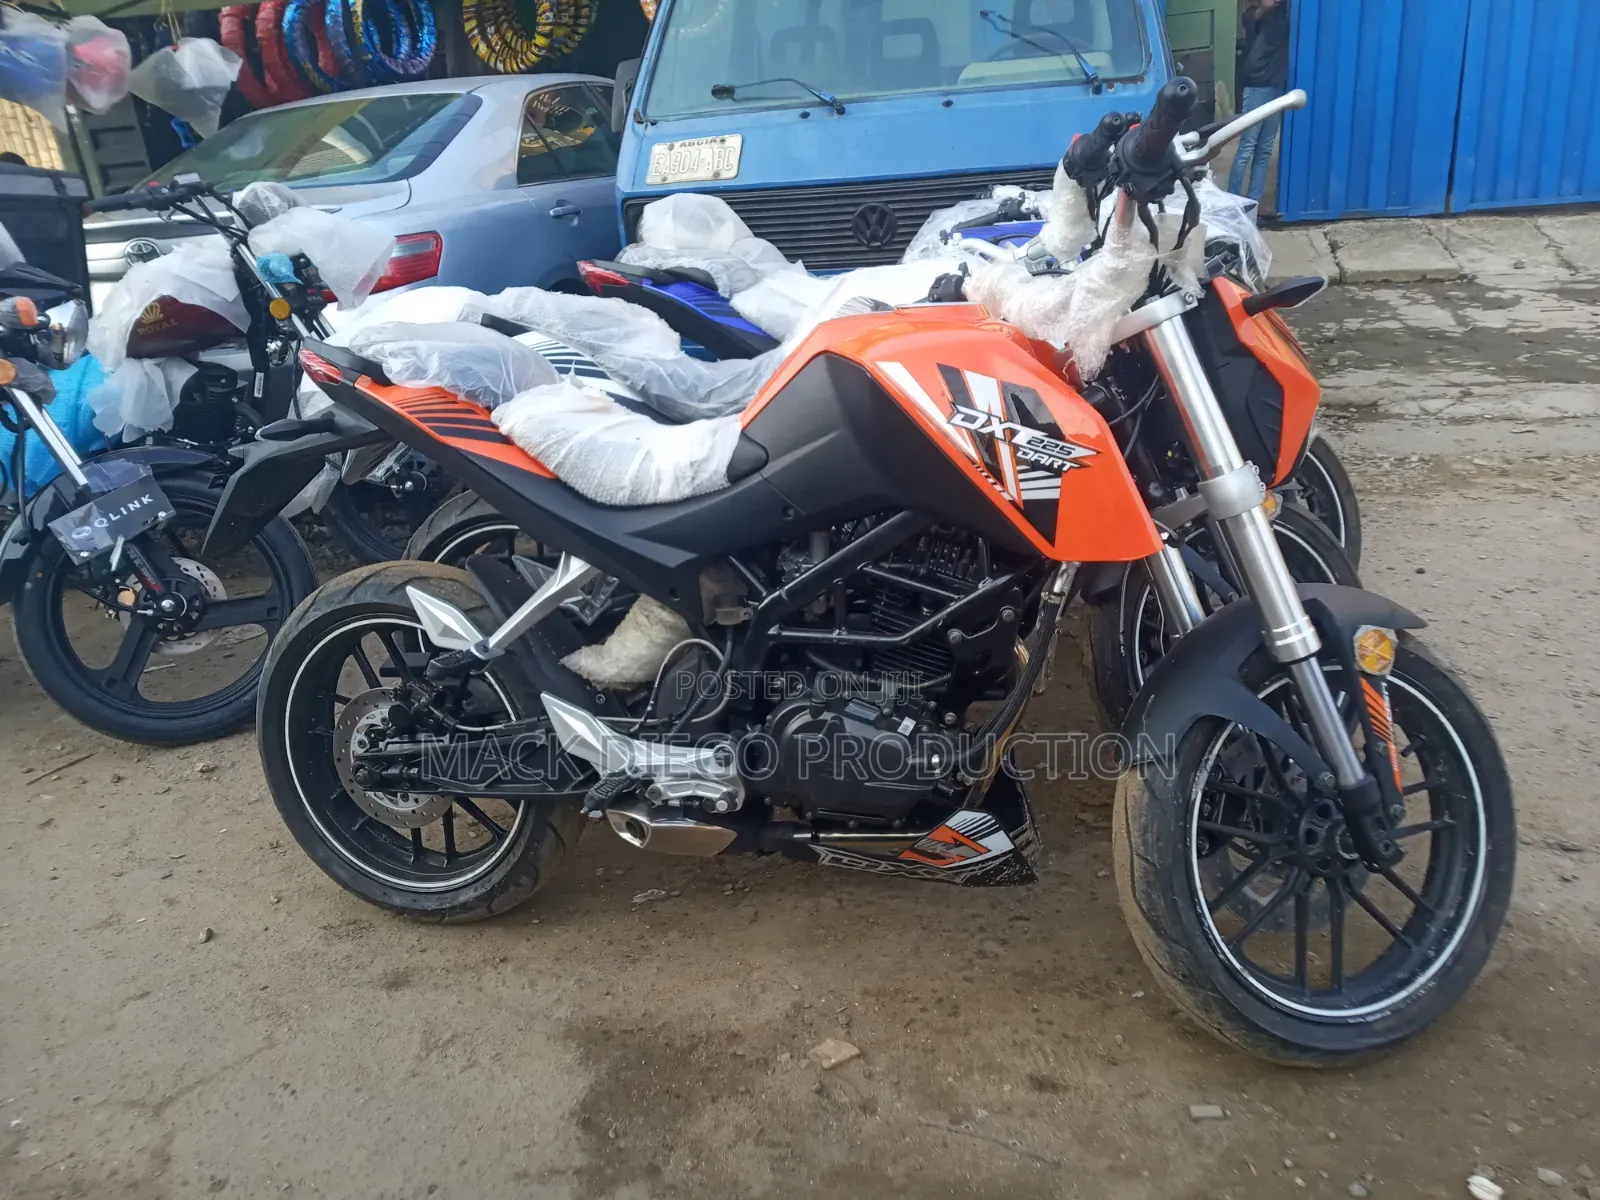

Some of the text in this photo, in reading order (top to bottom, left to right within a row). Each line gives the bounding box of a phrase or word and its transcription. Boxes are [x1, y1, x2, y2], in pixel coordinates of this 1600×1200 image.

[137, 318, 180, 336] ROYAL
[947, 403, 1076, 457] DXT 225
[1016, 446, 1081, 473] DART
[94, 493, 155, 529] QLINK
